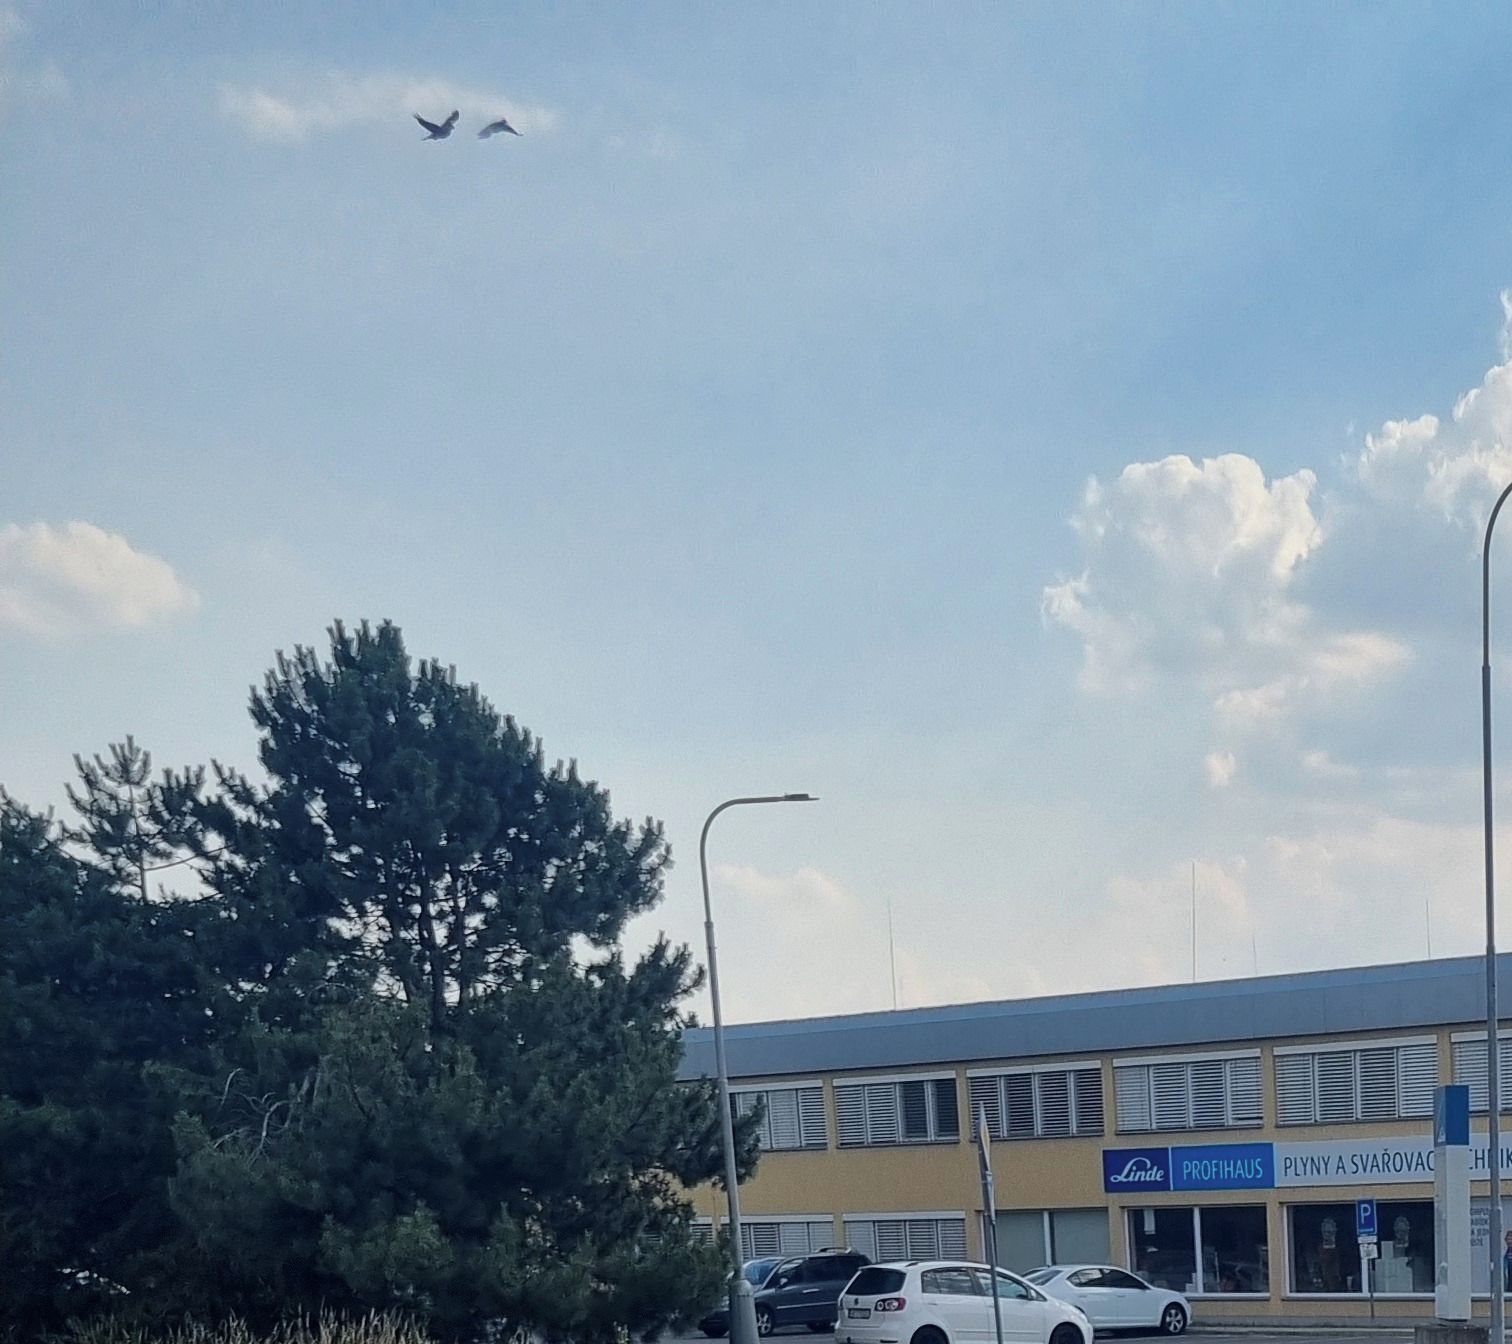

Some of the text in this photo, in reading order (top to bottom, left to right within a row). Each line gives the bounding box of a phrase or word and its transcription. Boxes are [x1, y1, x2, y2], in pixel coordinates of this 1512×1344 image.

[1110, 1156, 1165, 1183] Linde
[1183, 1158, 1264, 1181] PROFIHAUS
[1284, 1155, 1331, 1177] PLYNY
[1335, 1153, 1347, 1175] A
[1351, 1147, 1435, 1175] SVAŘOVAC
[1360, 1203, 1371, 1225] P
